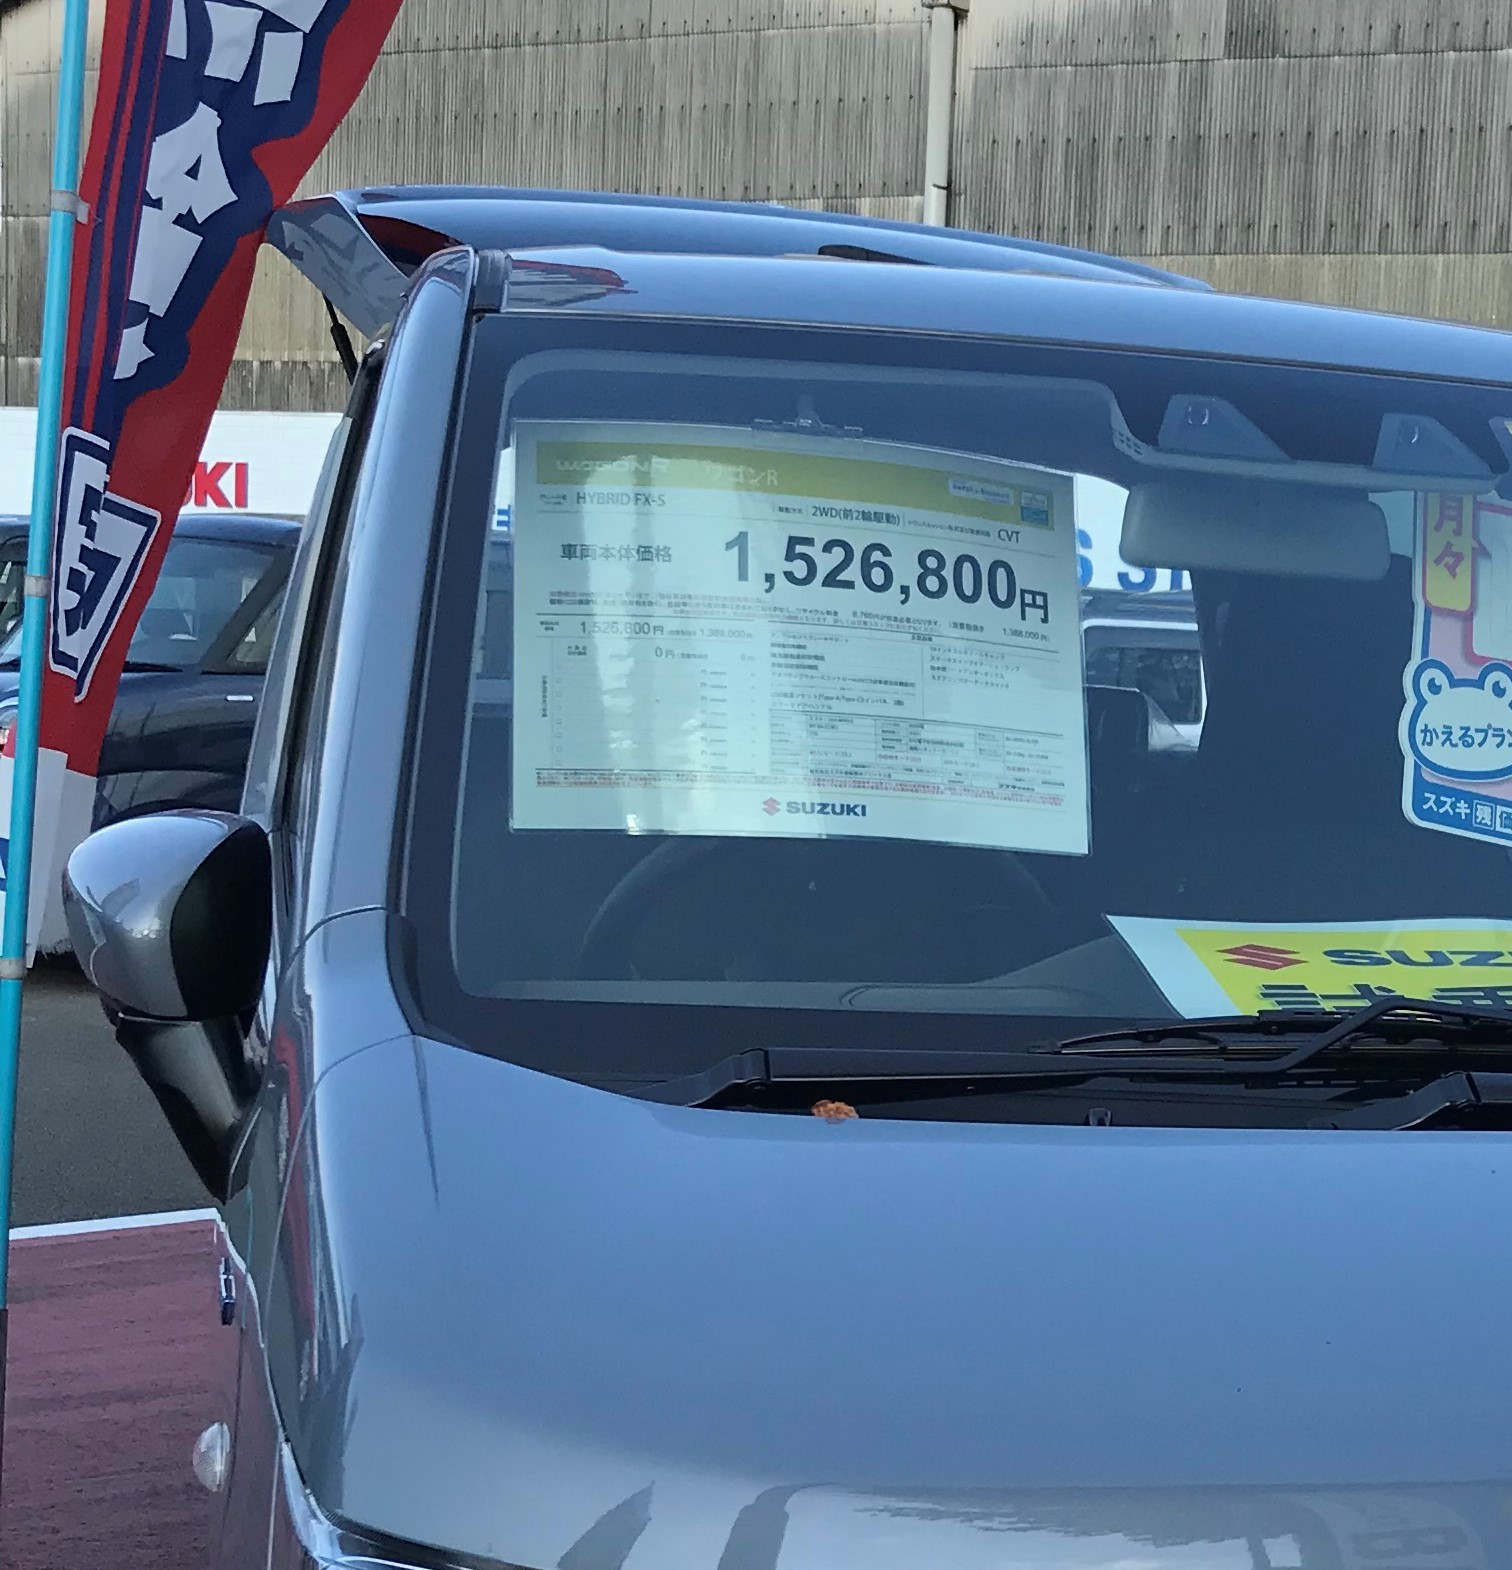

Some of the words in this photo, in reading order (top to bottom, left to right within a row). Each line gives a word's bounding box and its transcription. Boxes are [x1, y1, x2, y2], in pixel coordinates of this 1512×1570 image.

[576, 492, 631, 506] HYBRID
[997, 528, 1021, 544] CVT
[560, 542, 673, 563] 車両本体価格
[786, 801, 867, 817] SUZUKI
